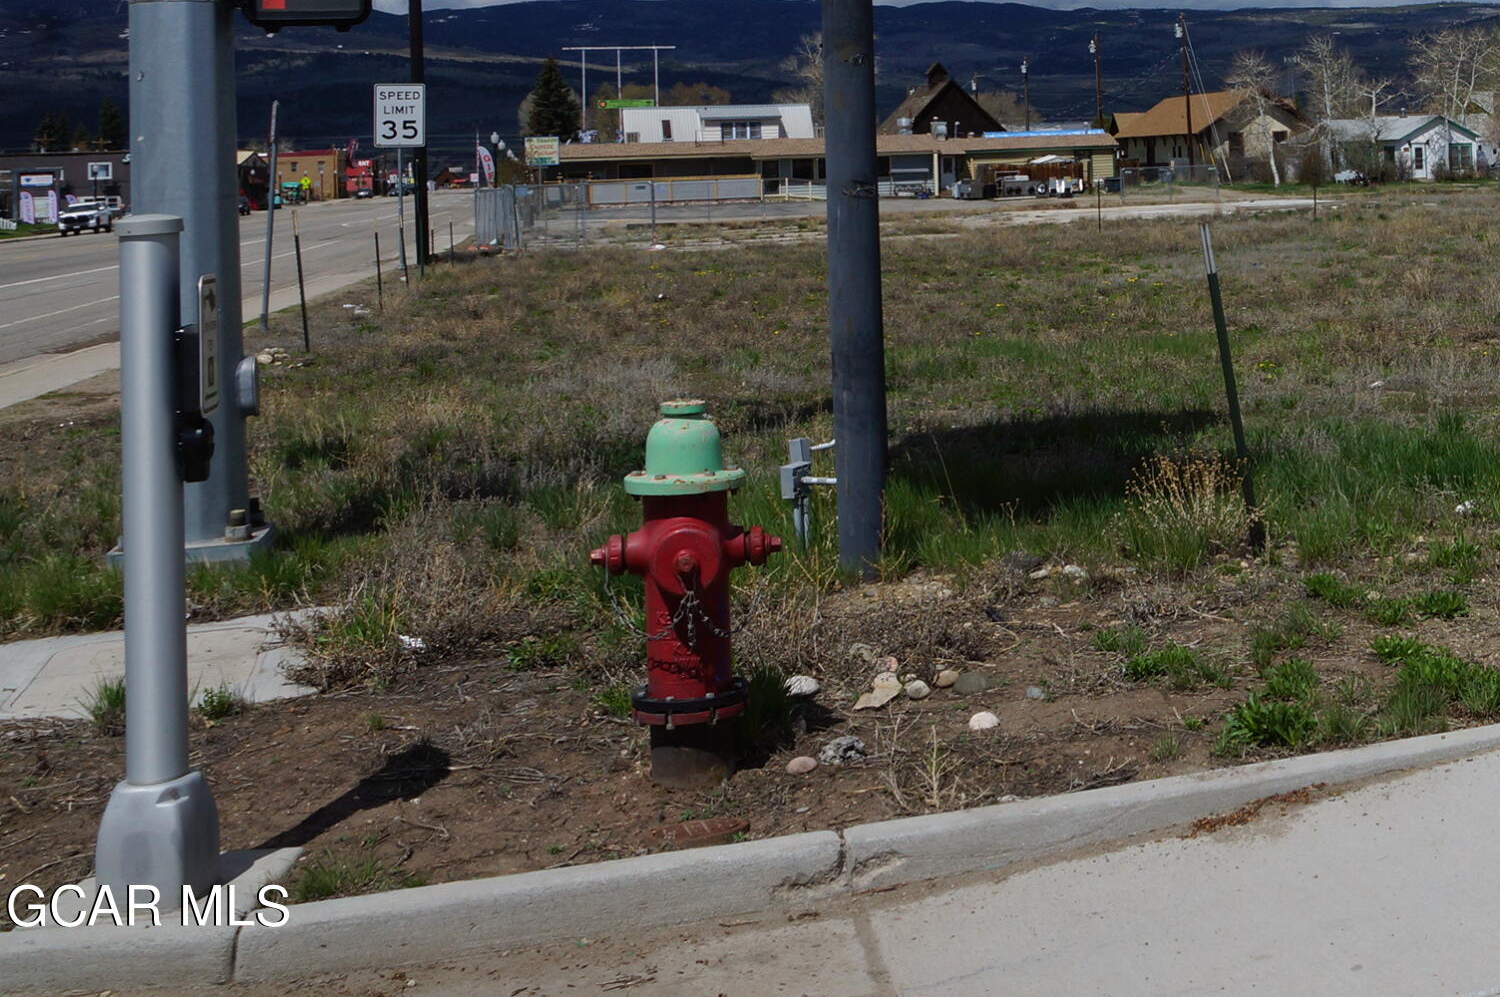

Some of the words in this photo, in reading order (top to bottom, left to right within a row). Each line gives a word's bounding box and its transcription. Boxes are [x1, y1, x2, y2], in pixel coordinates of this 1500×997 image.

[379, 91, 421, 101] SPEED
[383, 105, 416, 115] LIMIT
[381, 120, 418, 140] 35
